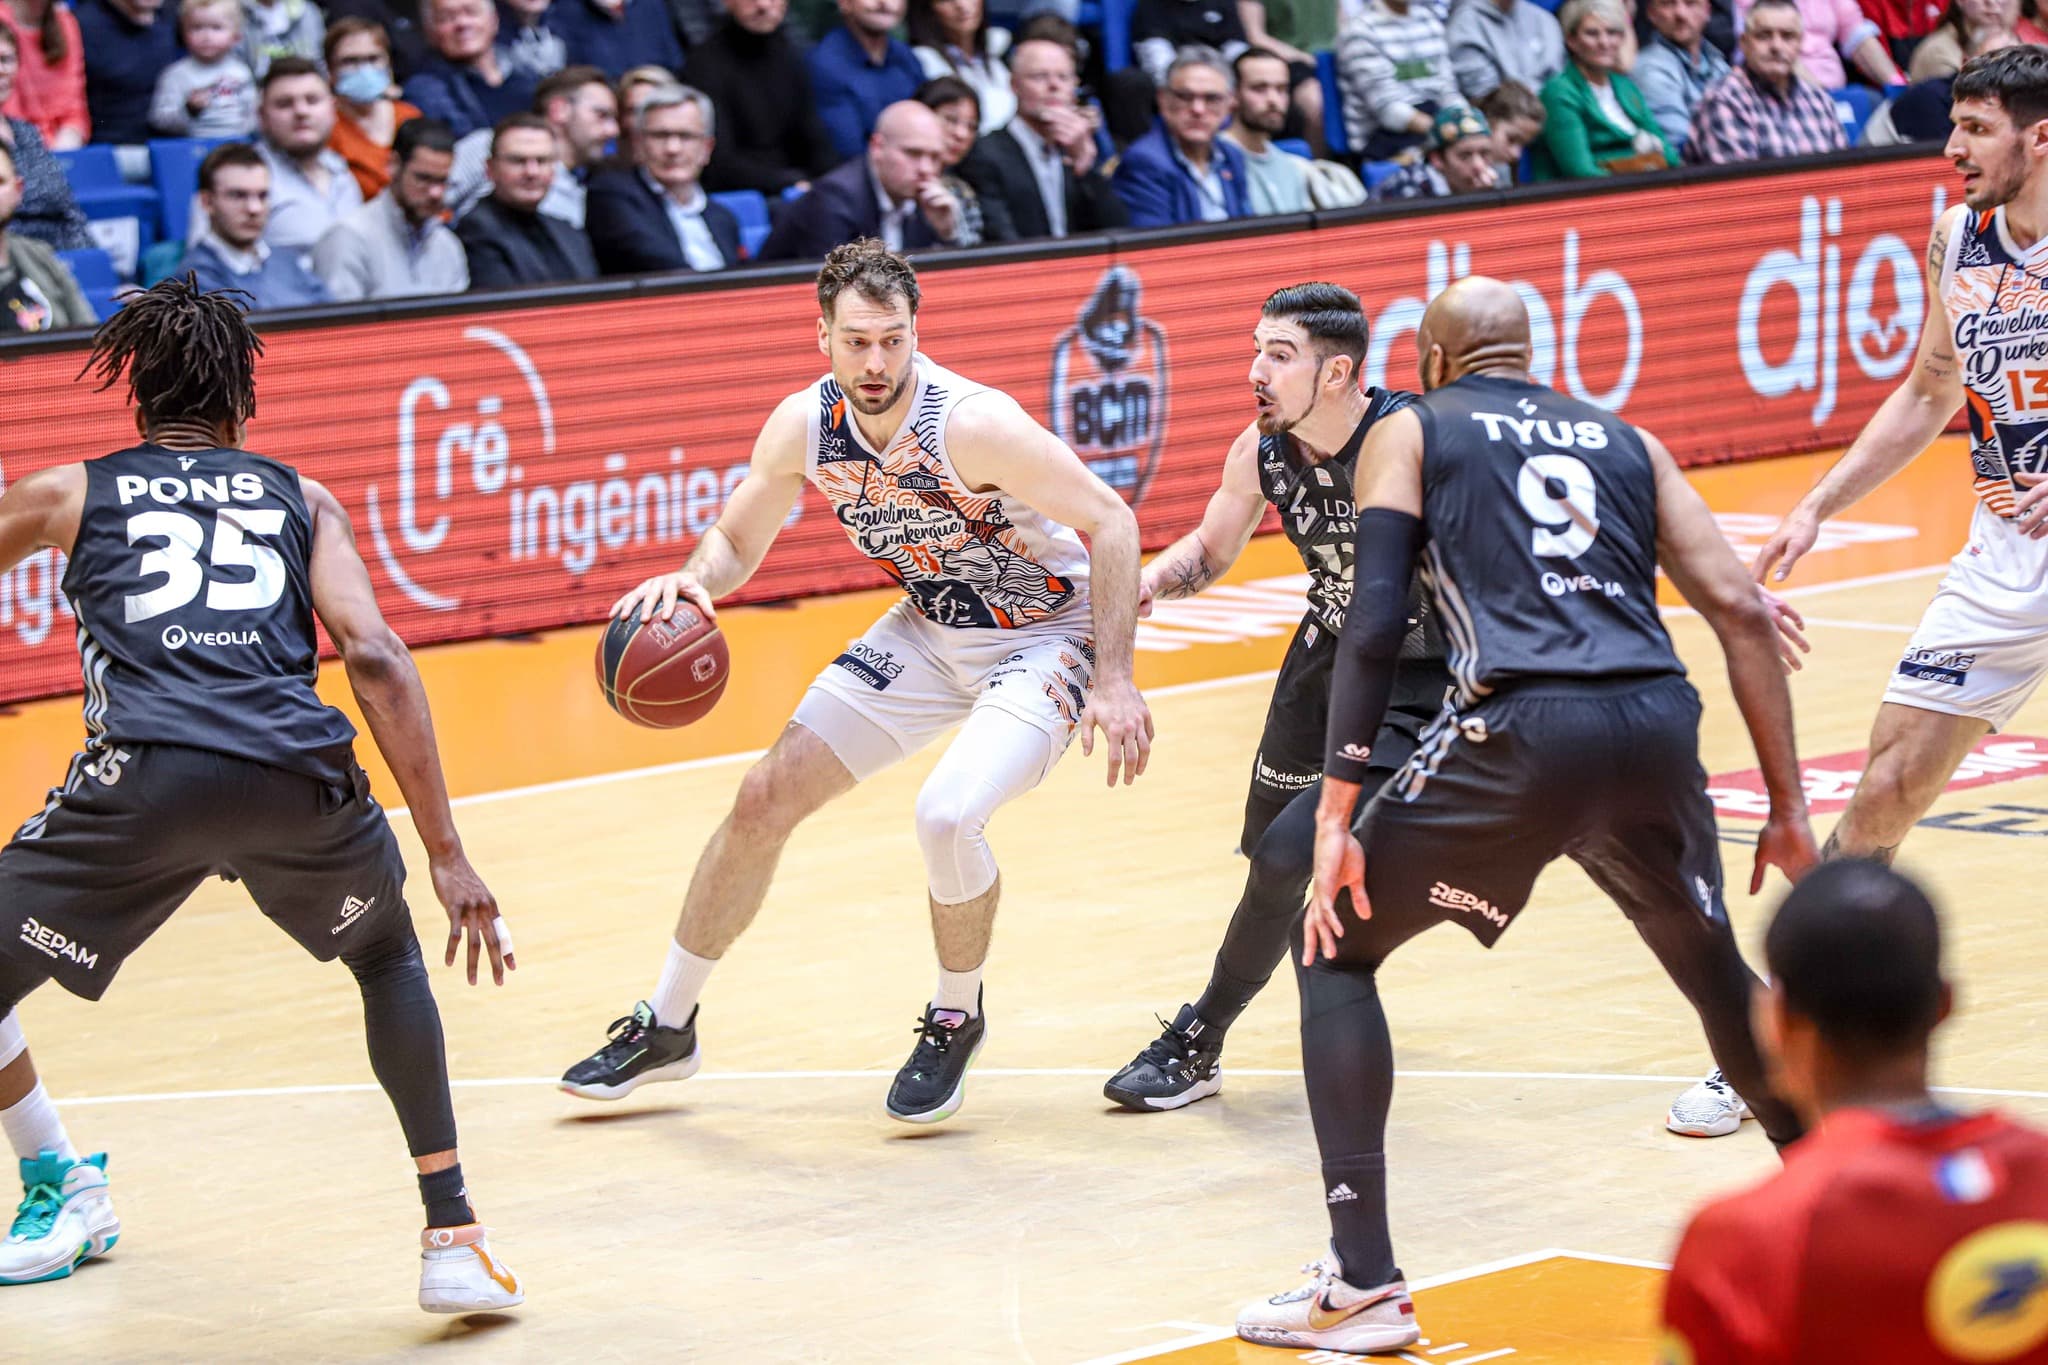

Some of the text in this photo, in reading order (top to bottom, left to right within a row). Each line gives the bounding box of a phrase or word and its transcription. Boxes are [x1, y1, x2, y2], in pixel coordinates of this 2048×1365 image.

[1955, 307, 2048, 349] Graveline
[1072, 380, 1152, 447] BCM
[1471, 411, 1609, 449] TYUS
[116, 472, 265, 505] PONS
[510, 446, 804, 575] ingénie
[1323, 498, 1359, 519] LDL
[1516, 453, 1601, 560] 9
[124, 507, 287, 624] 35
[189, 630, 263, 647] VEOLIA
[842, 661, 880, 687] LOCATION
[1429, 881, 1509, 928] REPAM
[21, 916, 99, 970] REPAM
